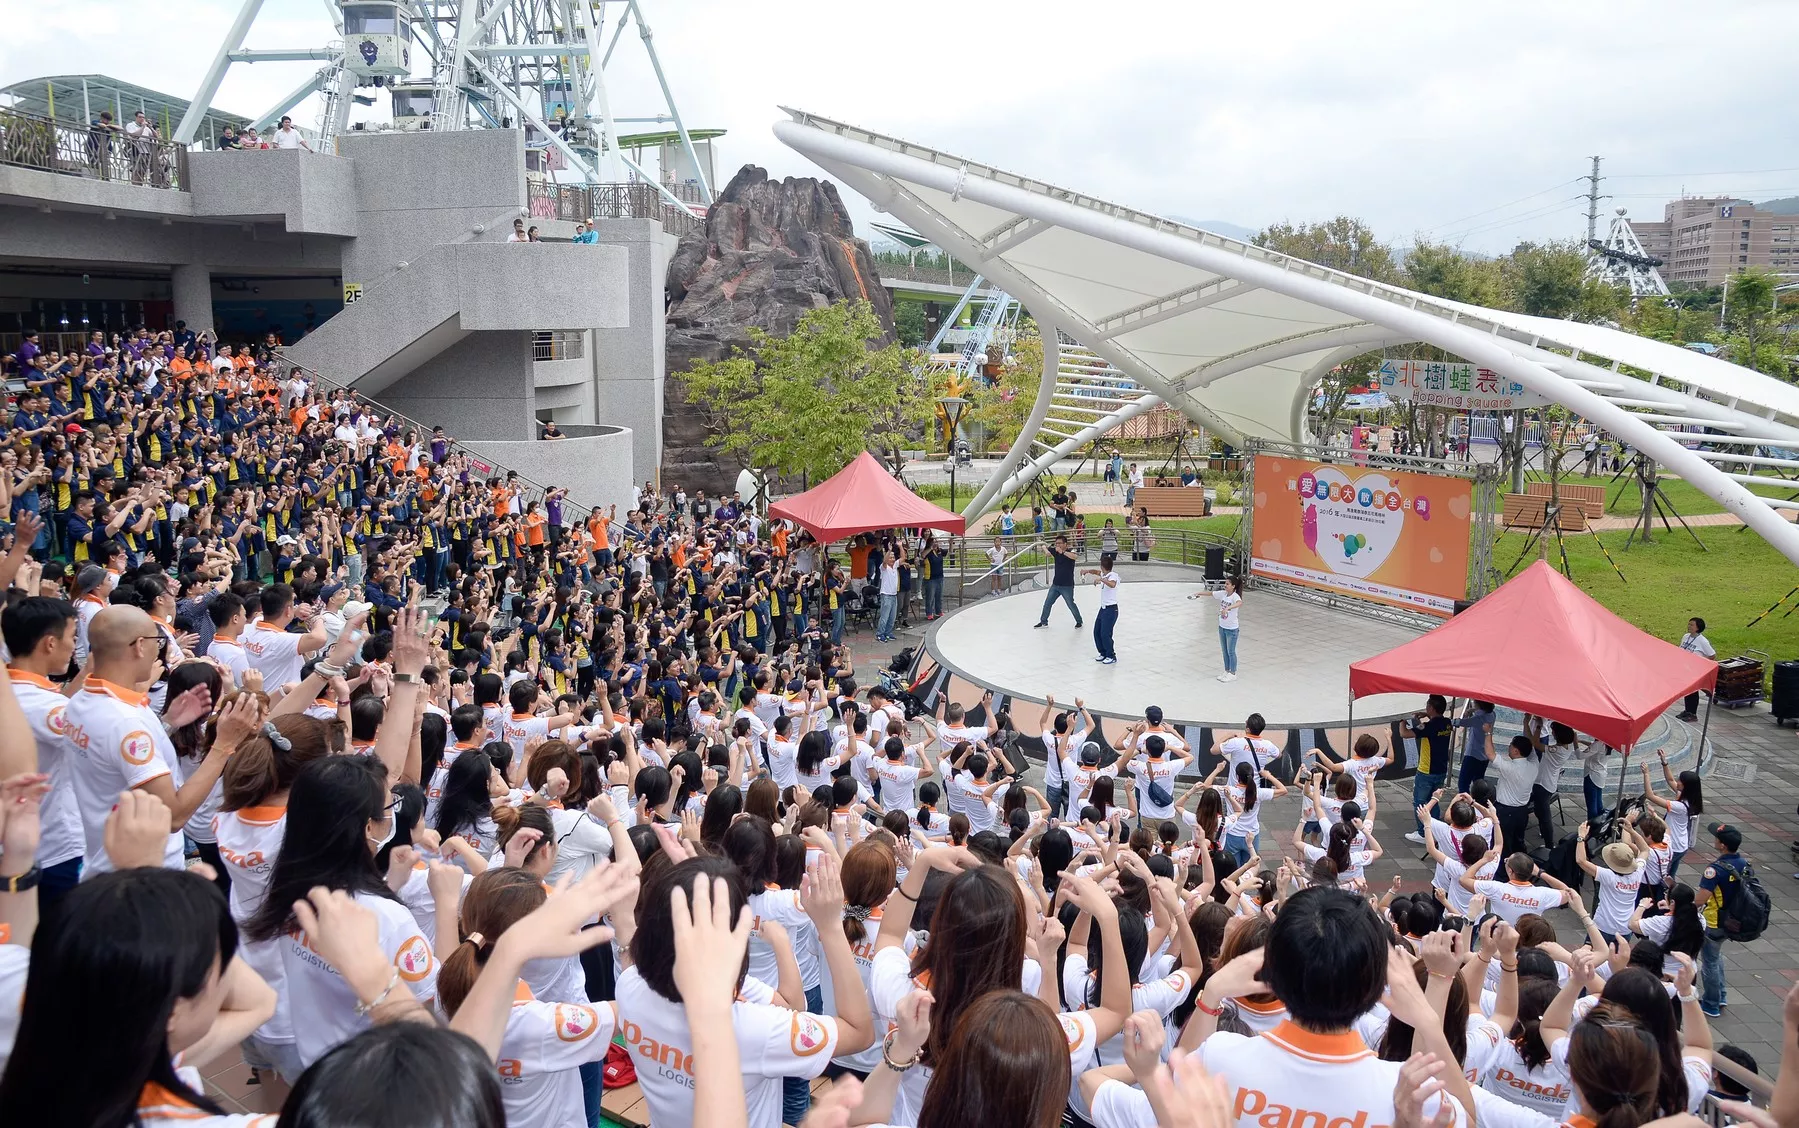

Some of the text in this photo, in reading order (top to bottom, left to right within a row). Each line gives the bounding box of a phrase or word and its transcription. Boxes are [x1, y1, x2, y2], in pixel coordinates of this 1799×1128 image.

[345, 290, 362, 303] 2F
[1412, 390, 1463, 408] Hopping
[1319, 507, 1333, 516] 2016
[658, 1066, 696, 1090] LOGIS
[1521, 1090, 1568, 1104] LOGISTIC
